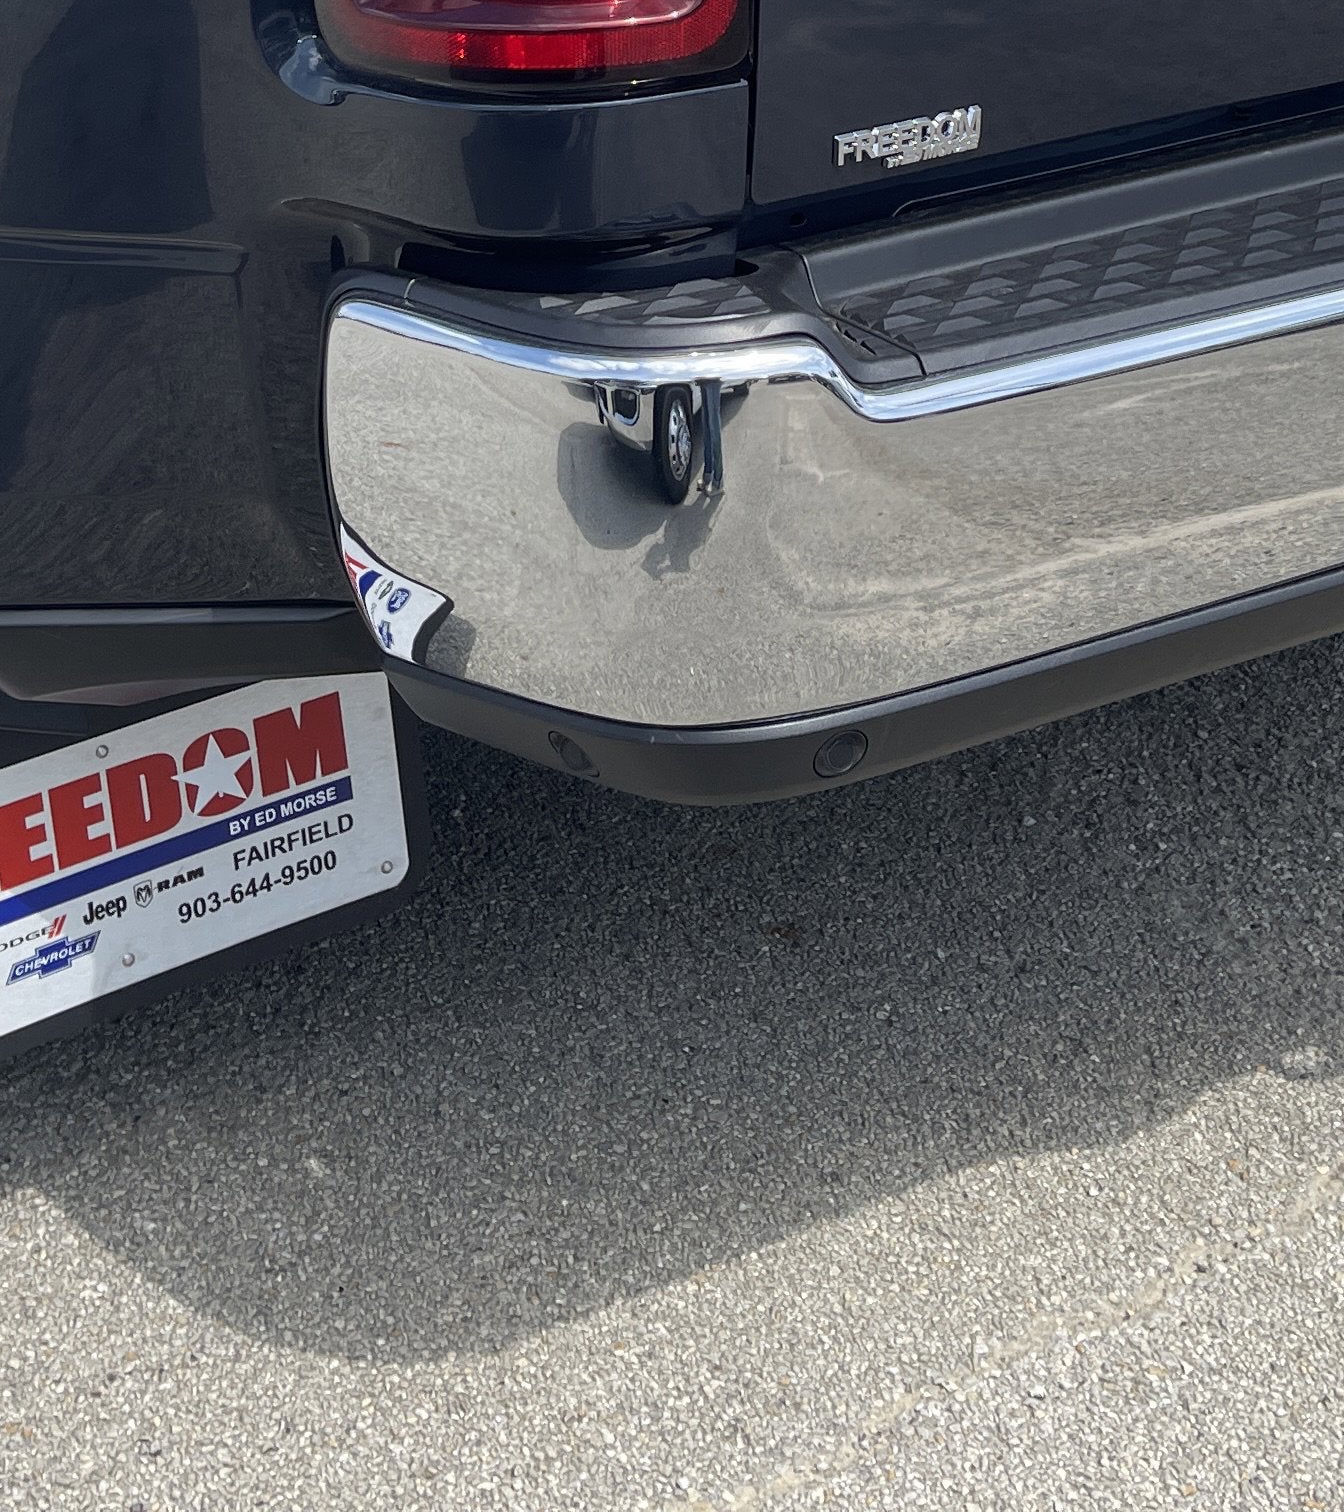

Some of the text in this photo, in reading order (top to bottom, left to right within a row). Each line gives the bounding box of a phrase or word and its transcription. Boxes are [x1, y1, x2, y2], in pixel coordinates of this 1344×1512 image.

[834, 105, 982, 167] FREEDOM
[229, 786, 337, 836] BY ED MORSE
[232, 813, 354, 871] FAIRFIELD
[156, 866, 205, 893] RAM
[178, 849, 337, 924] 903-644-9500
[82, 895, 127, 925] Jeep
[15, 939, 91, 977] CHEVROLET
